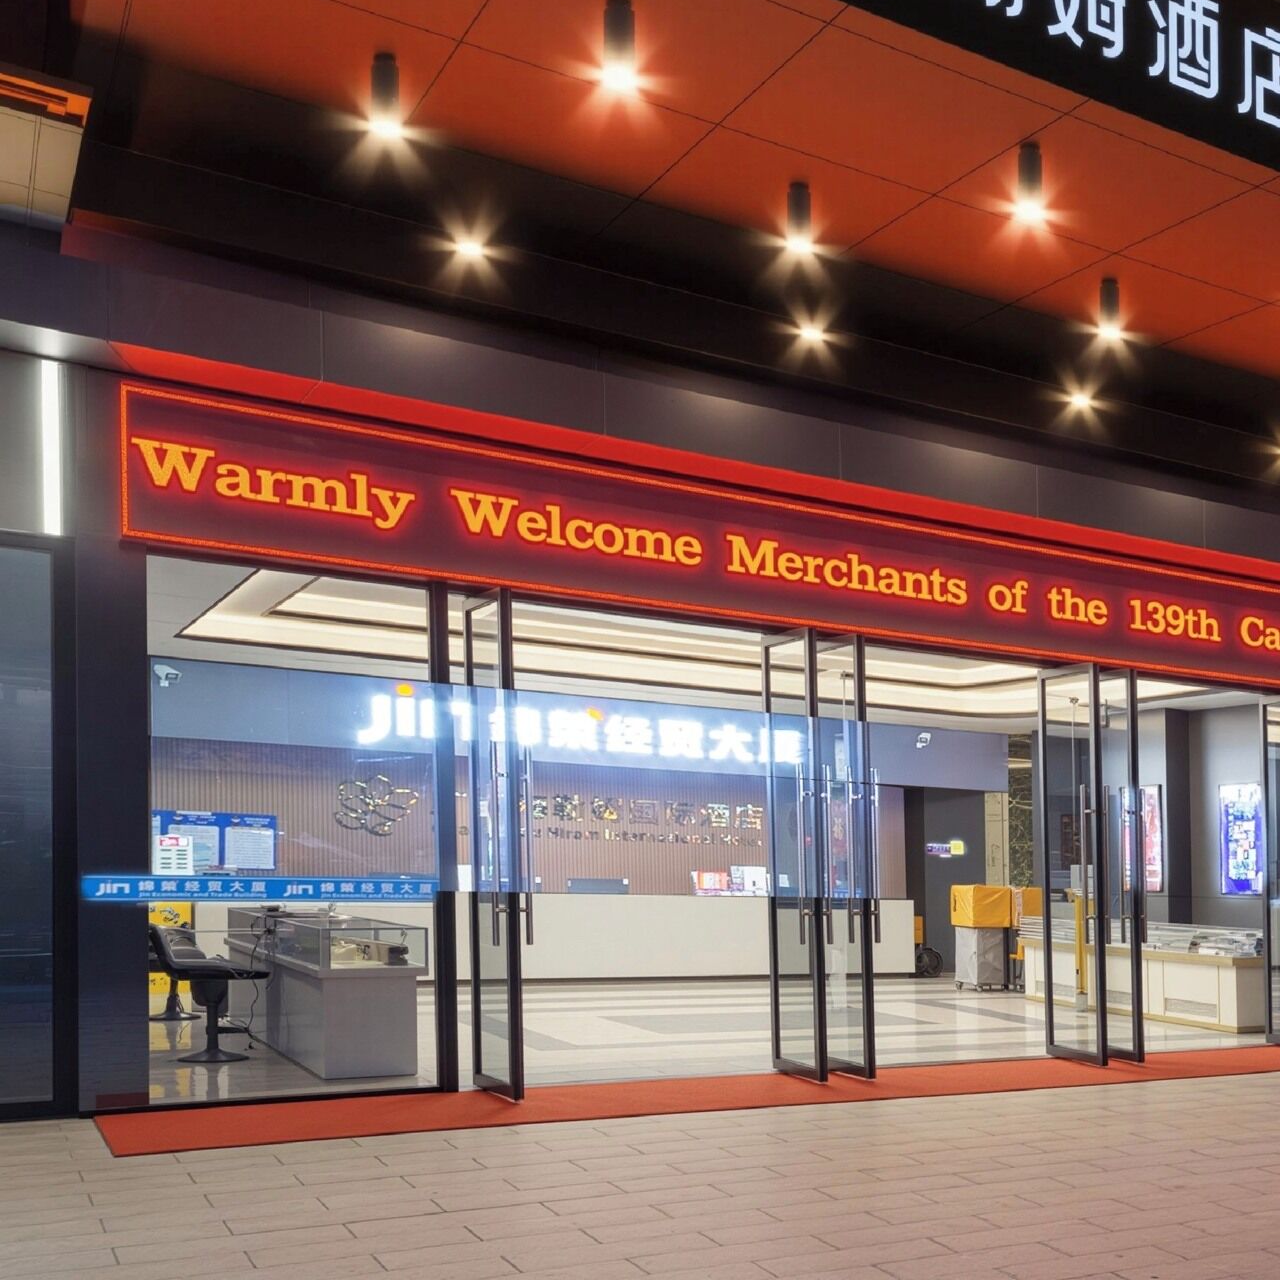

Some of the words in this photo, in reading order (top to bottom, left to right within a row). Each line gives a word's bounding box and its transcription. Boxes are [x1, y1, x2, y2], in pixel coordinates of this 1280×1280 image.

[132, 437, 415, 529] Warmly
[451, 489, 702, 565] Welcome
[726, 534, 967, 605] Merchants
[988, 581, 1028, 612] of
[1049, 587, 1108, 625] the
[1130, 599, 1221, 642] 139th
